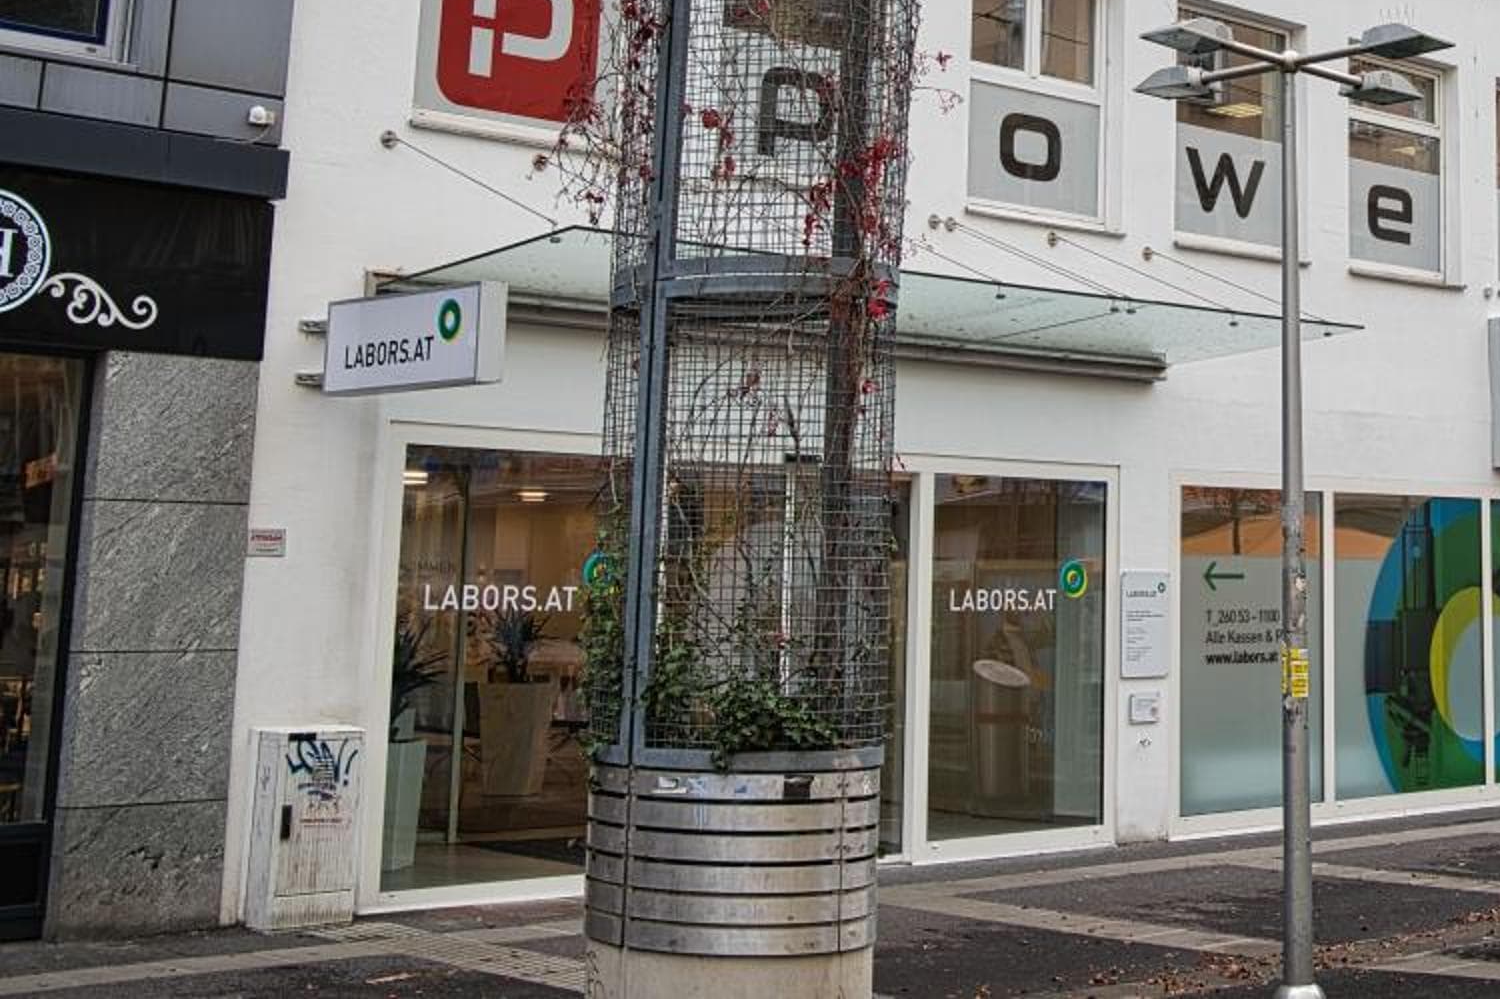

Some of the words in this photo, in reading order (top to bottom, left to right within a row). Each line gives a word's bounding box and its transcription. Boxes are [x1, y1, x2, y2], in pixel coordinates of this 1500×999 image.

[344, 335, 434, 370] LABORS.AT
[423, 584, 578, 612] LABORS.AT
[949, 589, 1056, 612] LABORS.AT
[1205, 649, 1279, 665] www.labors.at
